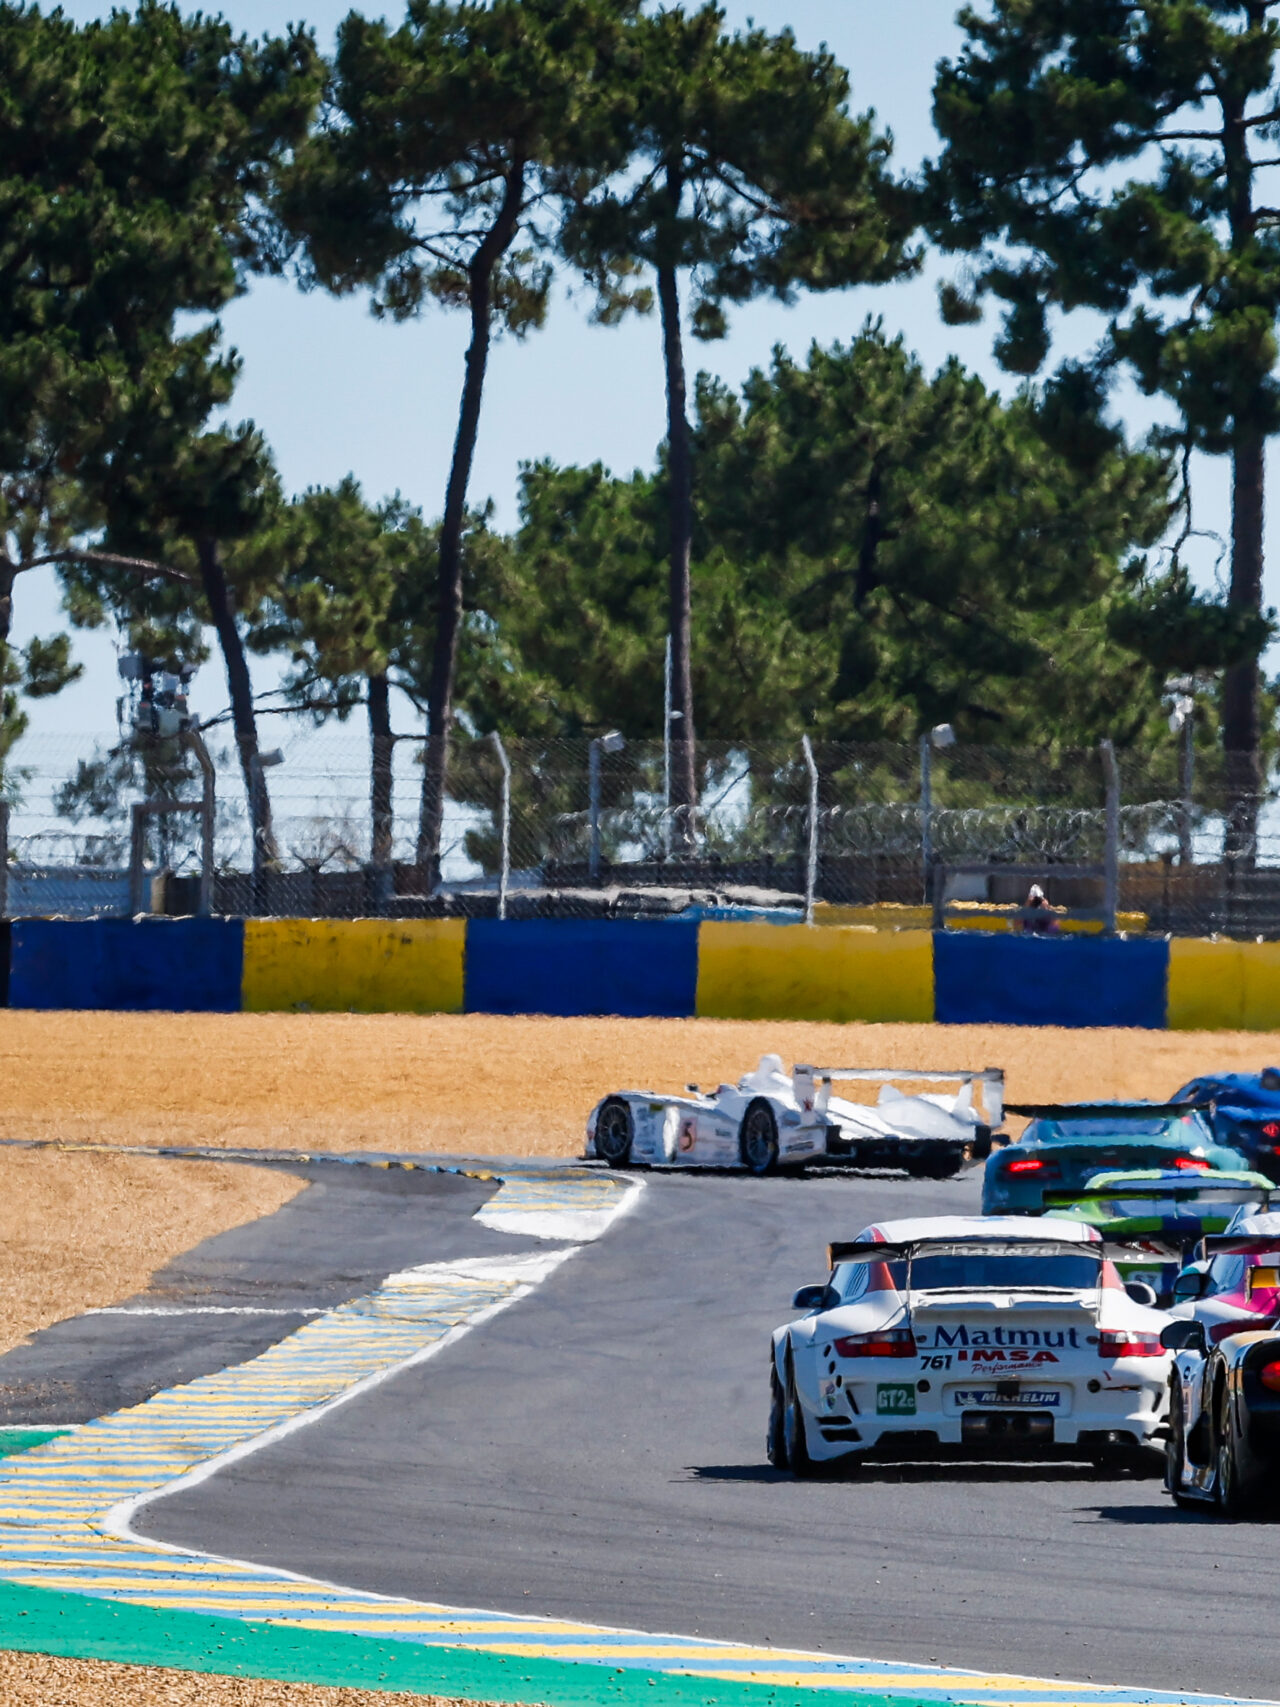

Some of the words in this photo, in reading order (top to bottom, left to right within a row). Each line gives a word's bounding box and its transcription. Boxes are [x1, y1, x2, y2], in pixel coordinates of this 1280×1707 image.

[934, 1324, 1080, 1348] Matmut
[920, 1354, 953, 1371] 761
[957, 1349, 1060, 1363] IMSA
